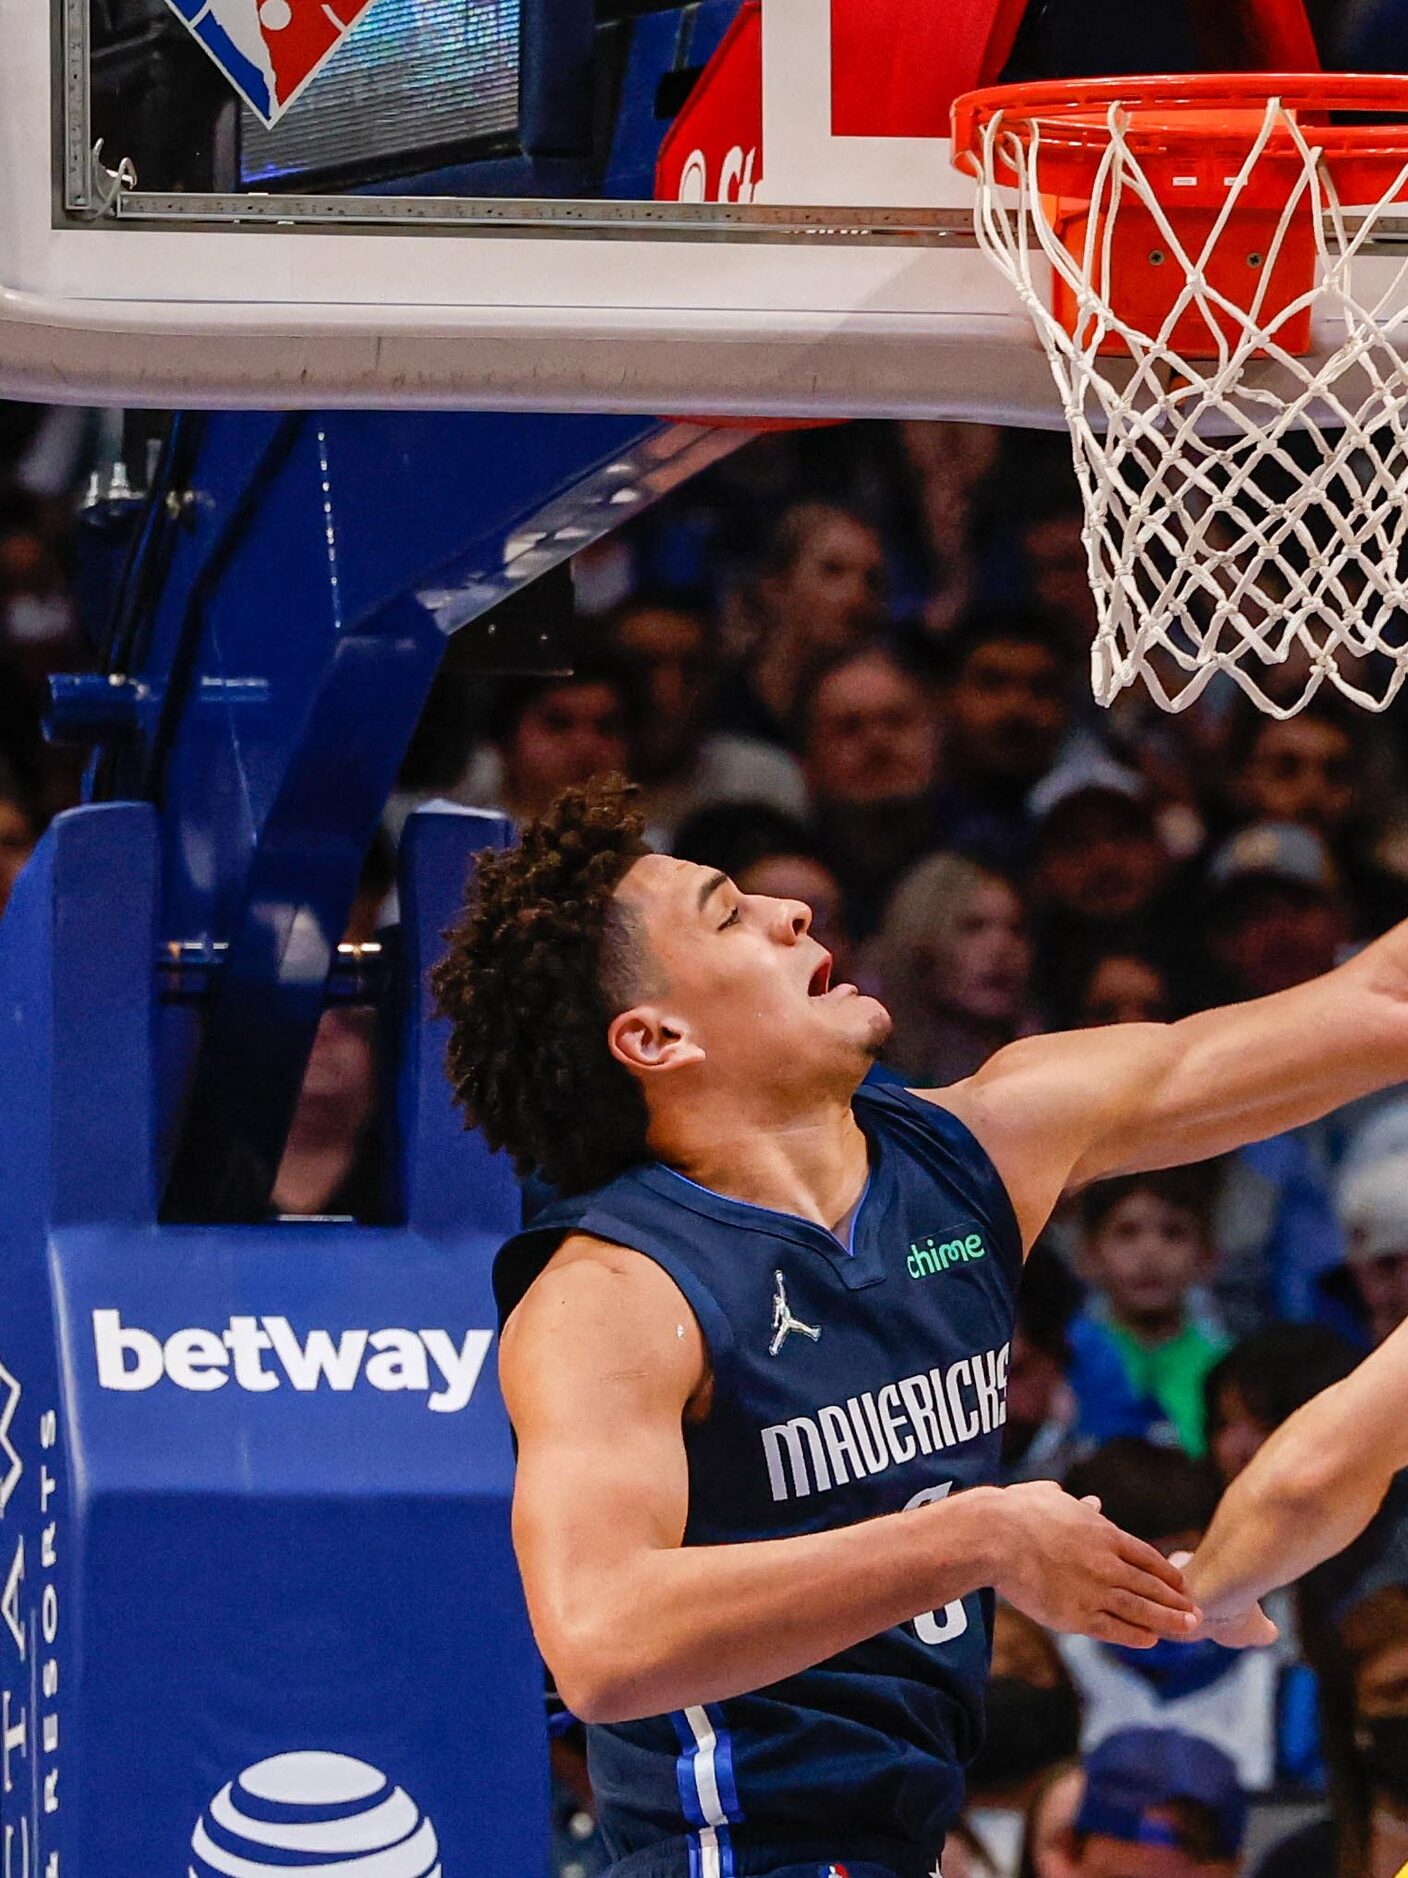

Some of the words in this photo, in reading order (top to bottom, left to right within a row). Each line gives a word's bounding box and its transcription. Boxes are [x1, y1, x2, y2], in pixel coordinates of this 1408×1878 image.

[906, 1233, 986, 1280] chime
[92, 1309, 494, 1413] betway
[40, 1410, 59, 1814] RESORTS
